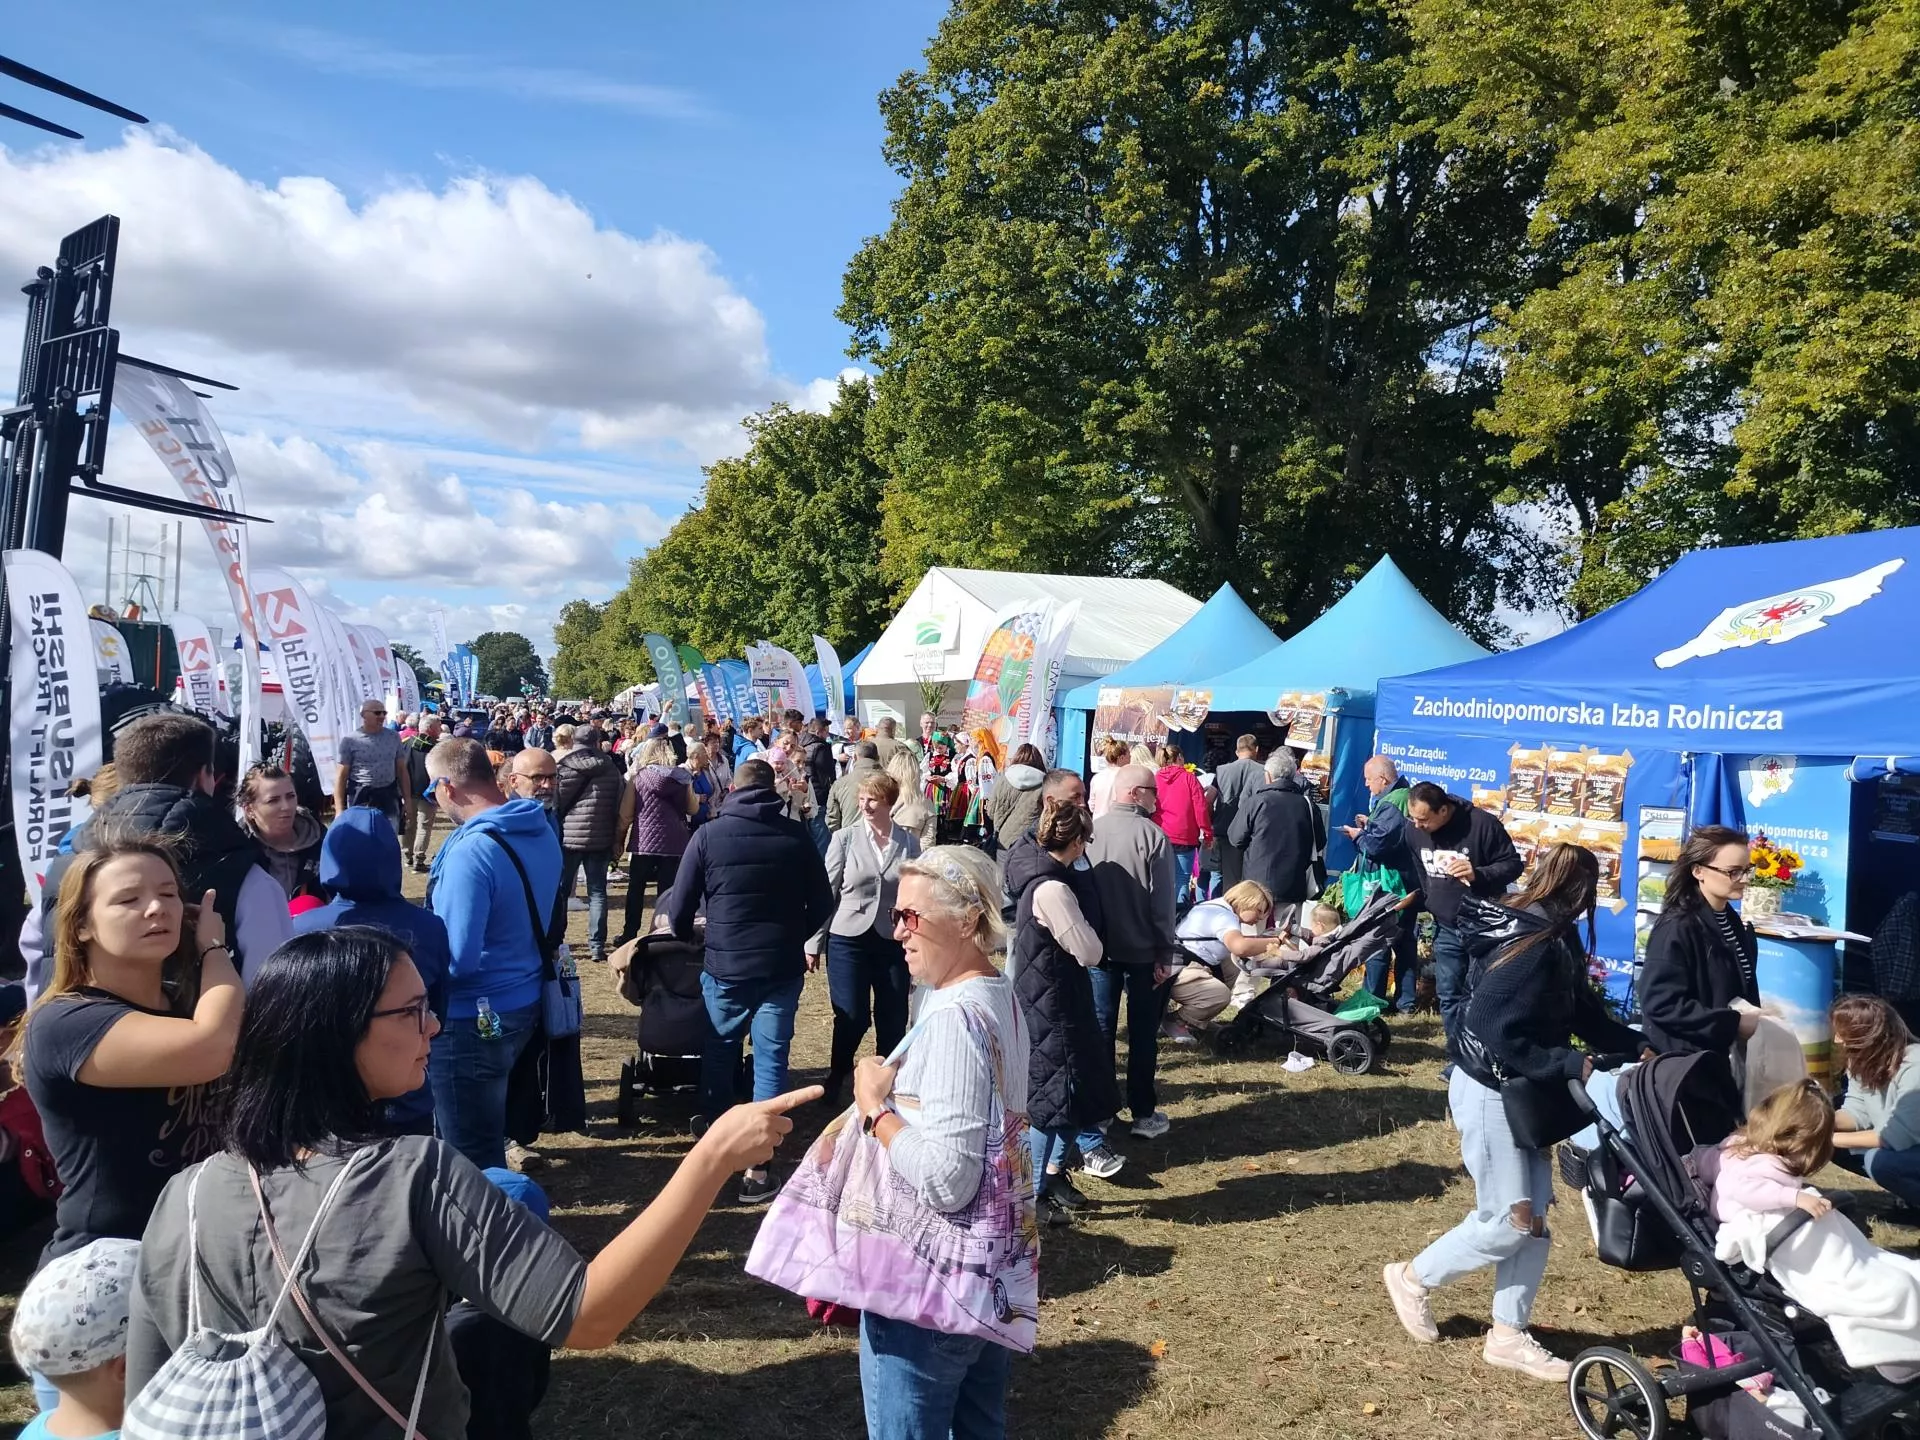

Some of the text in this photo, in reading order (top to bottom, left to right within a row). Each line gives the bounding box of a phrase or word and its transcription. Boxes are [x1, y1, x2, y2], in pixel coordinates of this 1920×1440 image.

[1413, 696, 1784, 731] Zachodniopomorska Izba Rolnicza
[1381, 743, 1448, 761] Biuro Zarządu:
[1394, 760, 1496, 783] Chmielewskiego 22a/9
